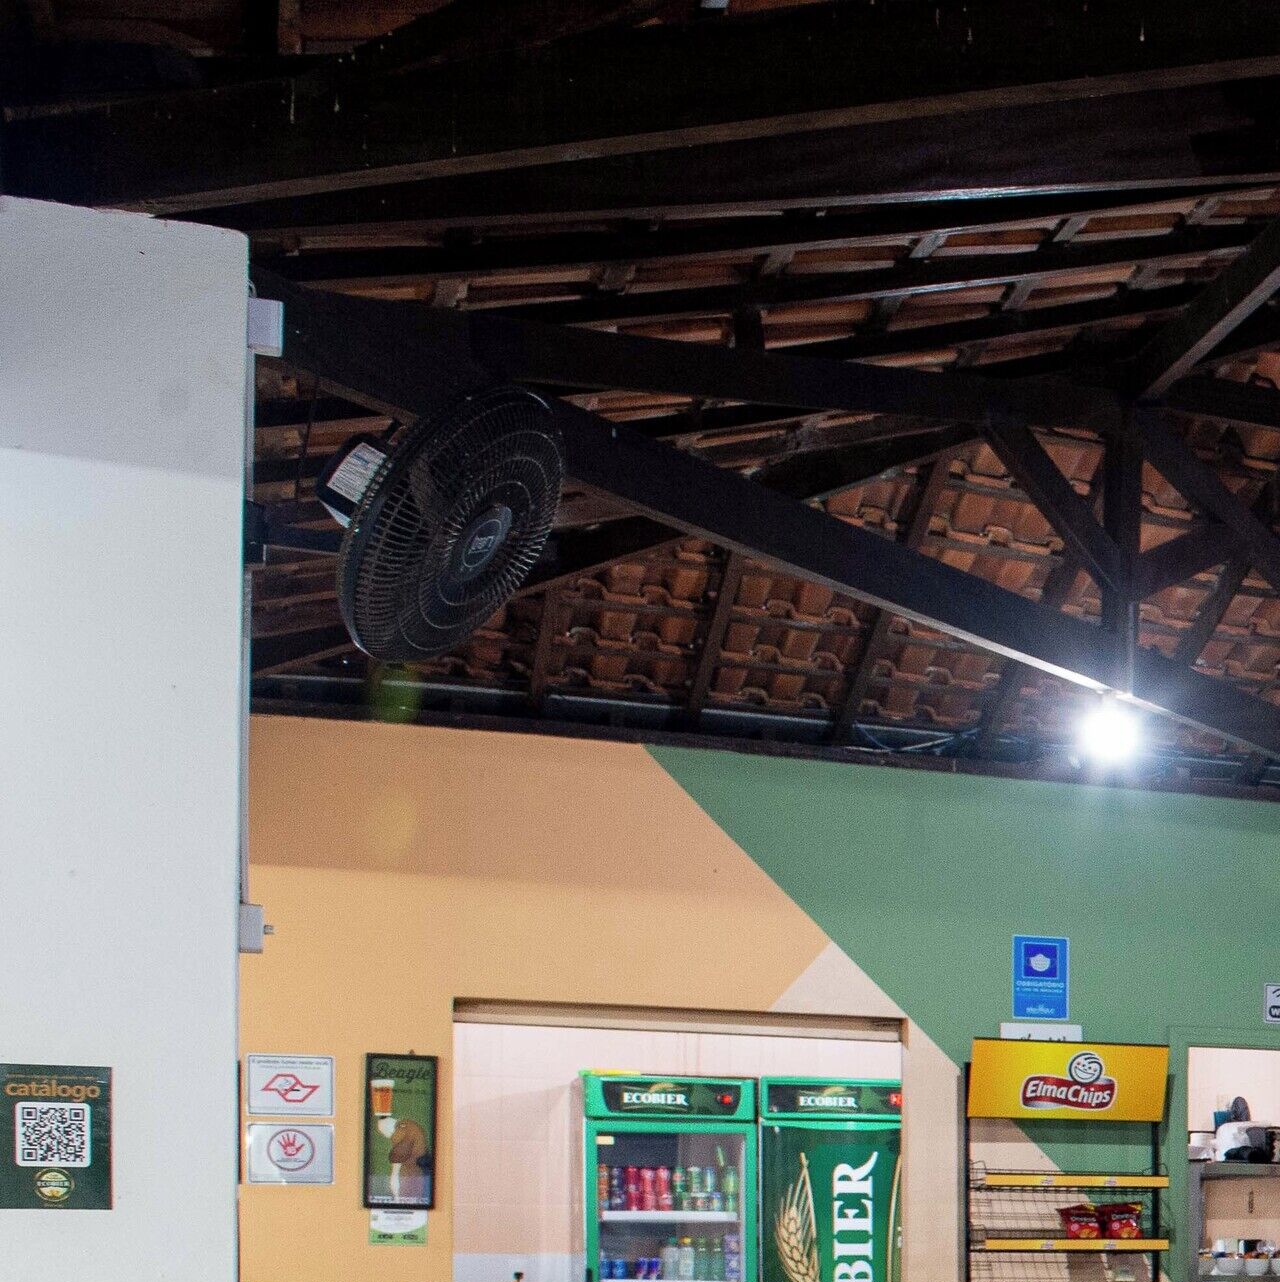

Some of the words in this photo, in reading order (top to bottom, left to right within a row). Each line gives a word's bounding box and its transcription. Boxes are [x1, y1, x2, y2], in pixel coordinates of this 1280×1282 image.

[4, 1079, 102, 1103] catálogo
[623, 1092, 689, 1107] ECOBIER
[798, 1096, 858, 1108] ECOBIER
